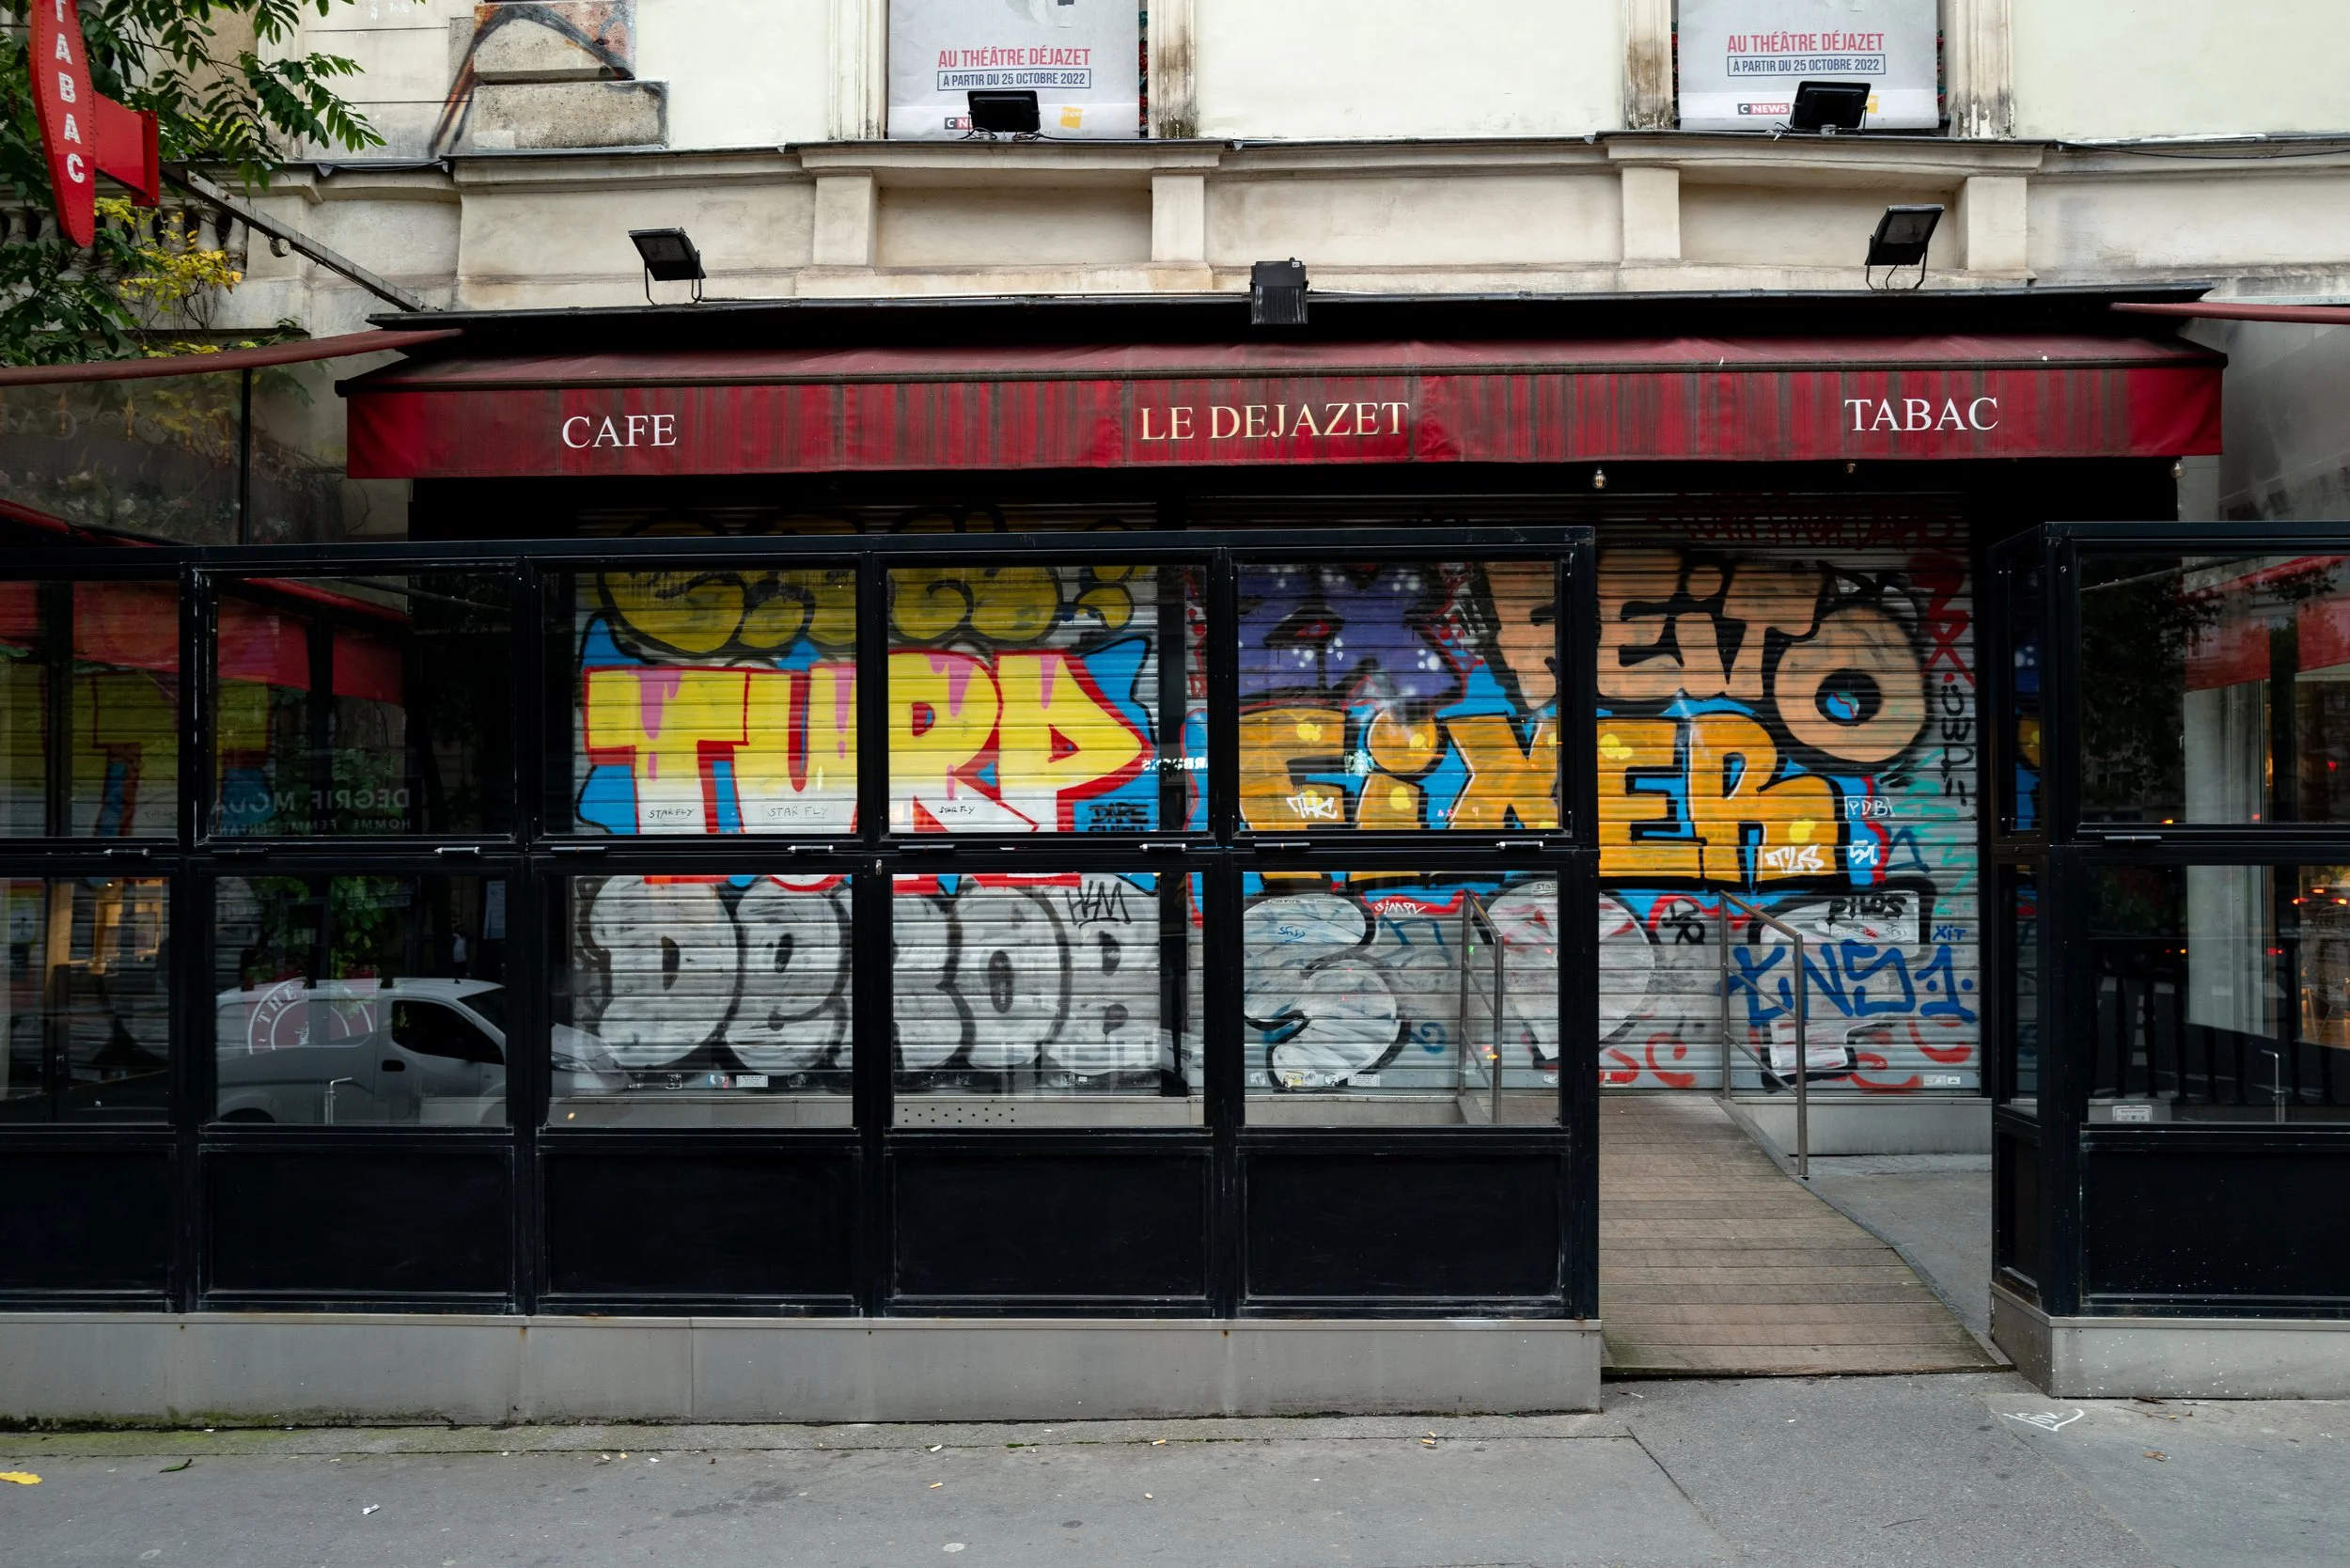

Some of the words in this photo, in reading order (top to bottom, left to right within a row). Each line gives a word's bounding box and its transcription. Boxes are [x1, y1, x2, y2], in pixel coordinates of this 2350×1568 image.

[1728, 35, 1747, 53] AU
[1751, 31, 1817, 53] THÉÂTRE
[1822, 30, 1884, 51] DÉJAZET
[938, 50, 957, 68] AU
[962, 46, 1025, 67] THÉÂTRE
[1029, 45, 1091, 66] DÉJAZET
[1733, 58, 1740, 72] À
[1743, 60, 1776, 72] PARTIR
[1778, 60, 1791, 71] DU
[1794, 59, 1806, 71] 25
[1809, 59, 1852, 71] OCTOBRE
[1855, 58, 1879, 71] 2022
[943, 73, 949, 86] À
[952, 74, 984, 86] PARTIR
[987, 74, 999, 85] DU
[1002, 73, 1013, 85] 25
[1016, 72, 1058, 85] OCTOBRE
[1060, 72, 1085, 85] 2022
[1140, 406, 1195, 440] LE
[1210, 401, 1409, 439] DEJAZET
[1844, 397, 1998, 431] TABAC
[562, 414, 678, 448] CAFE
